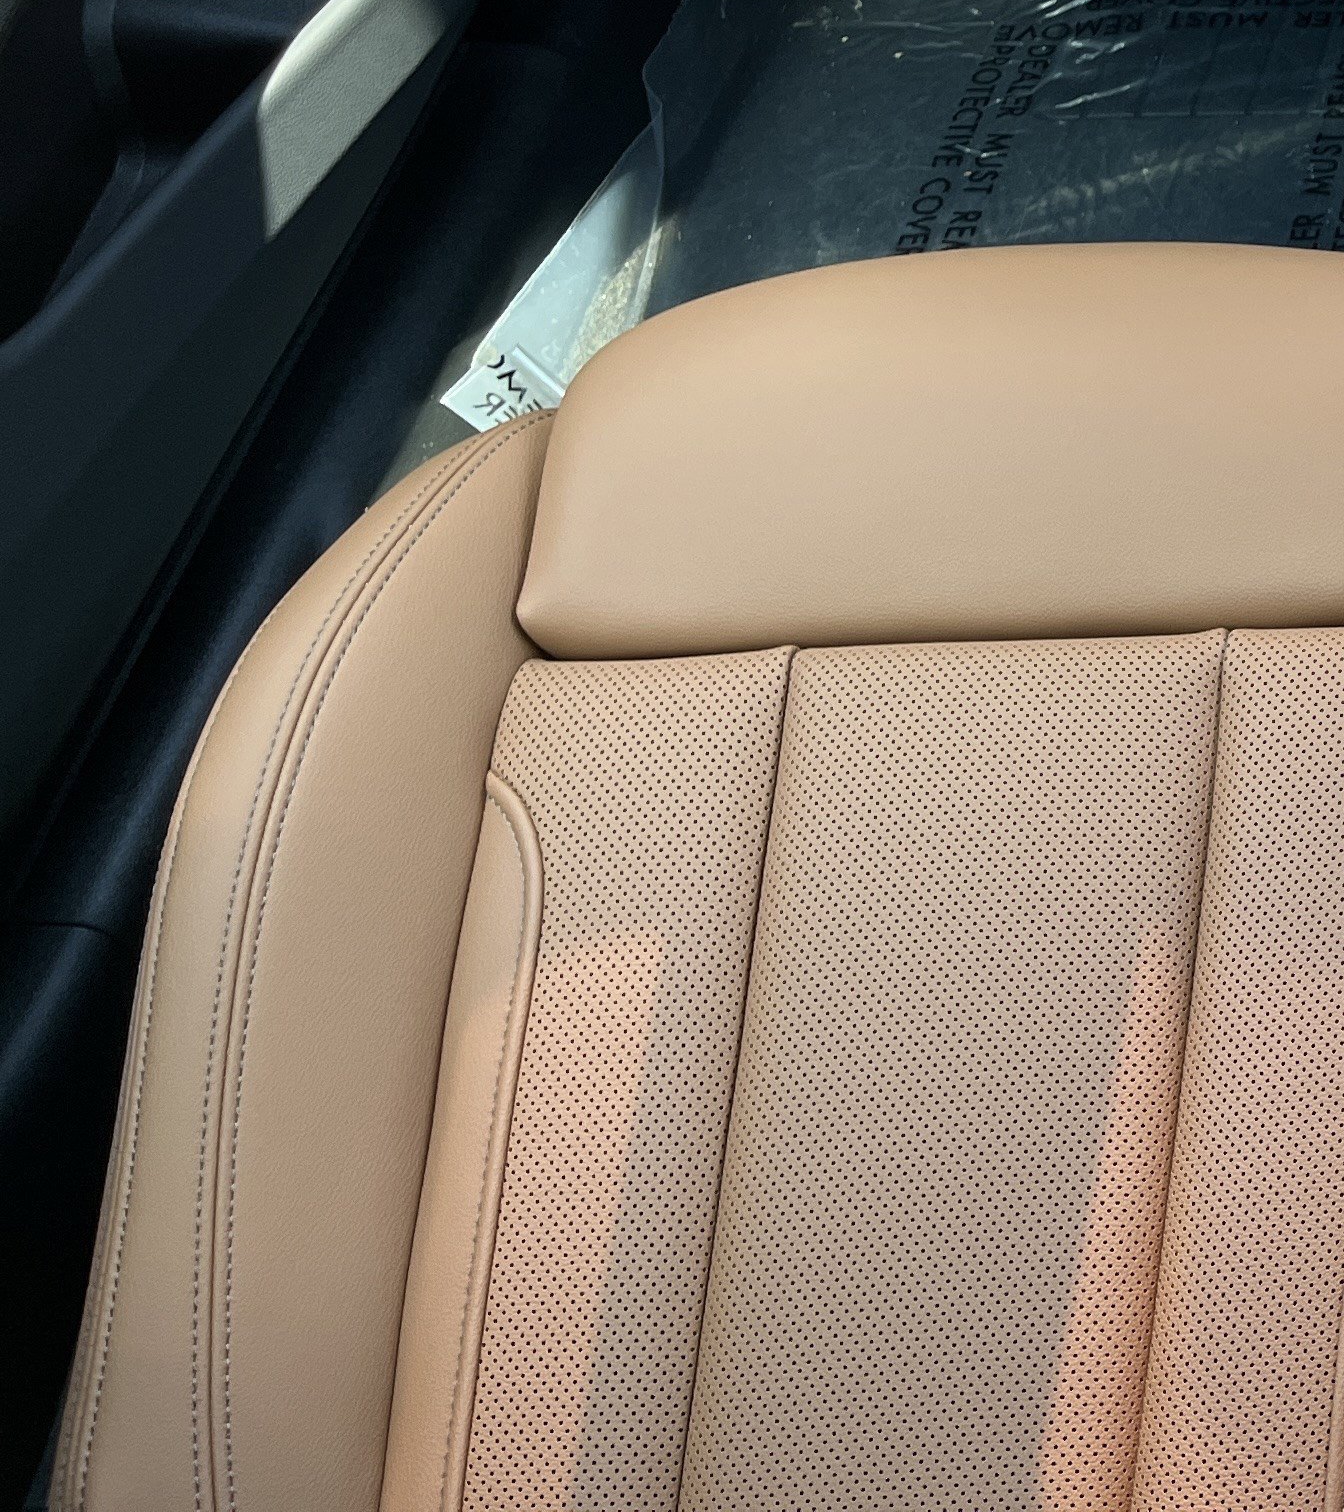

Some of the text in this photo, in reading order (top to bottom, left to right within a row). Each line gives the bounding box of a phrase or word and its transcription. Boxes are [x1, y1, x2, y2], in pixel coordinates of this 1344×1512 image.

[995, 11, 1146, 43] REMOVE
[1167, 9, 1269, 31] MUST
[931, 44, 1016, 169] PROTECTIVE
[962, 43, 1059, 195] DEALER MUST
